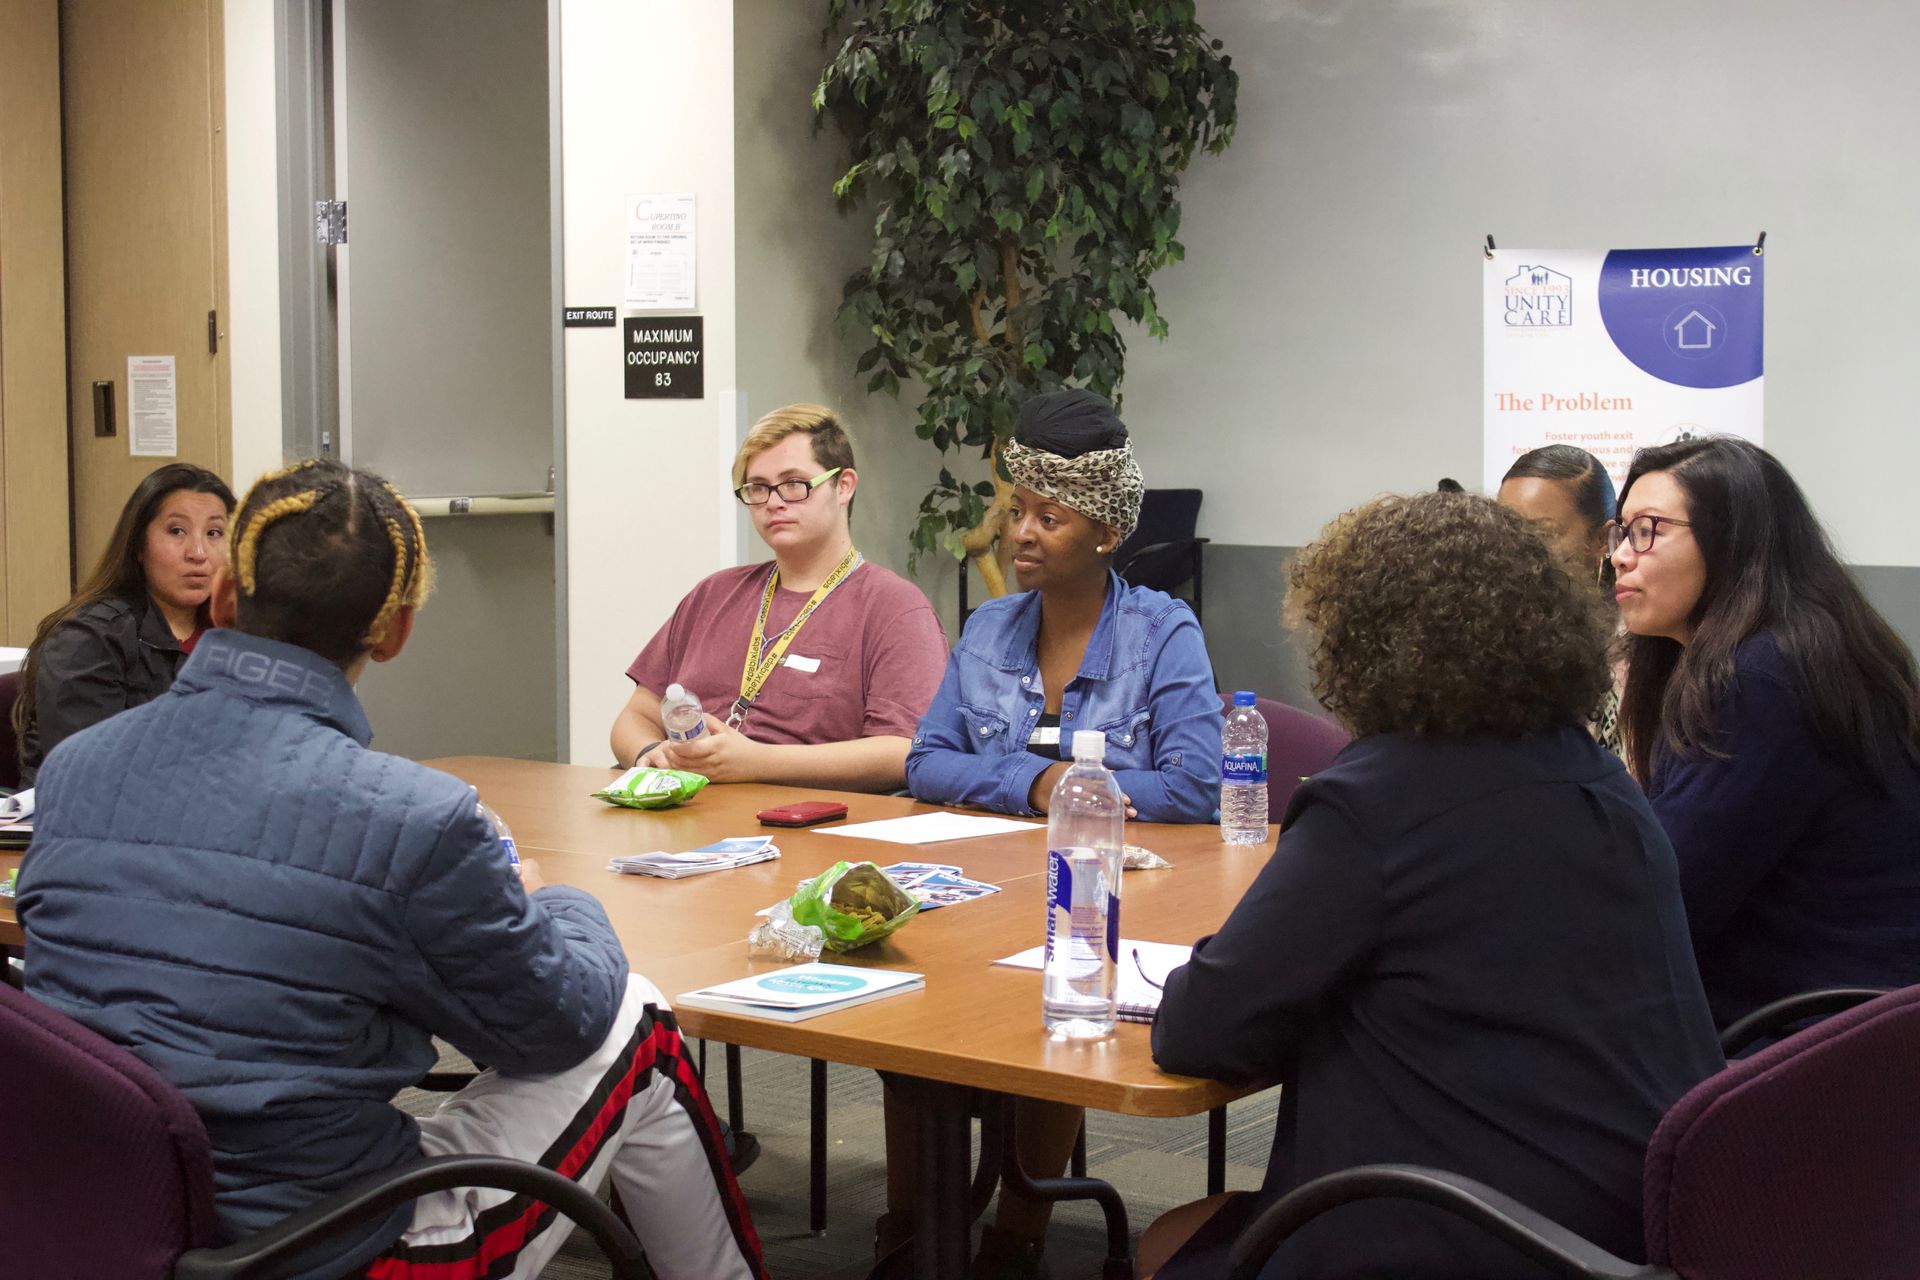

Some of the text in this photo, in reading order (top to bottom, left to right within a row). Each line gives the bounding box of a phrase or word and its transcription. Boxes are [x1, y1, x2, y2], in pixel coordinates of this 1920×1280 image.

[1630, 266, 1752, 288] HOUSING
[1505, 295, 1568, 311] UNITY
[566, 310, 614, 320] EXIT ROUTE
[1504, 310, 1567, 325] CARE
[633, 329, 693, 343] MAXIMUM
[627, 350, 700, 365] OCCUPANCY
[655, 372, 672, 386] 83
[1494, 391, 1633, 411] The Problem
[1545, 431, 1633, 443] Foster youth exit
[1613, 444, 1633, 454] and
[1224, 760, 1258, 772] AQUAFINA
